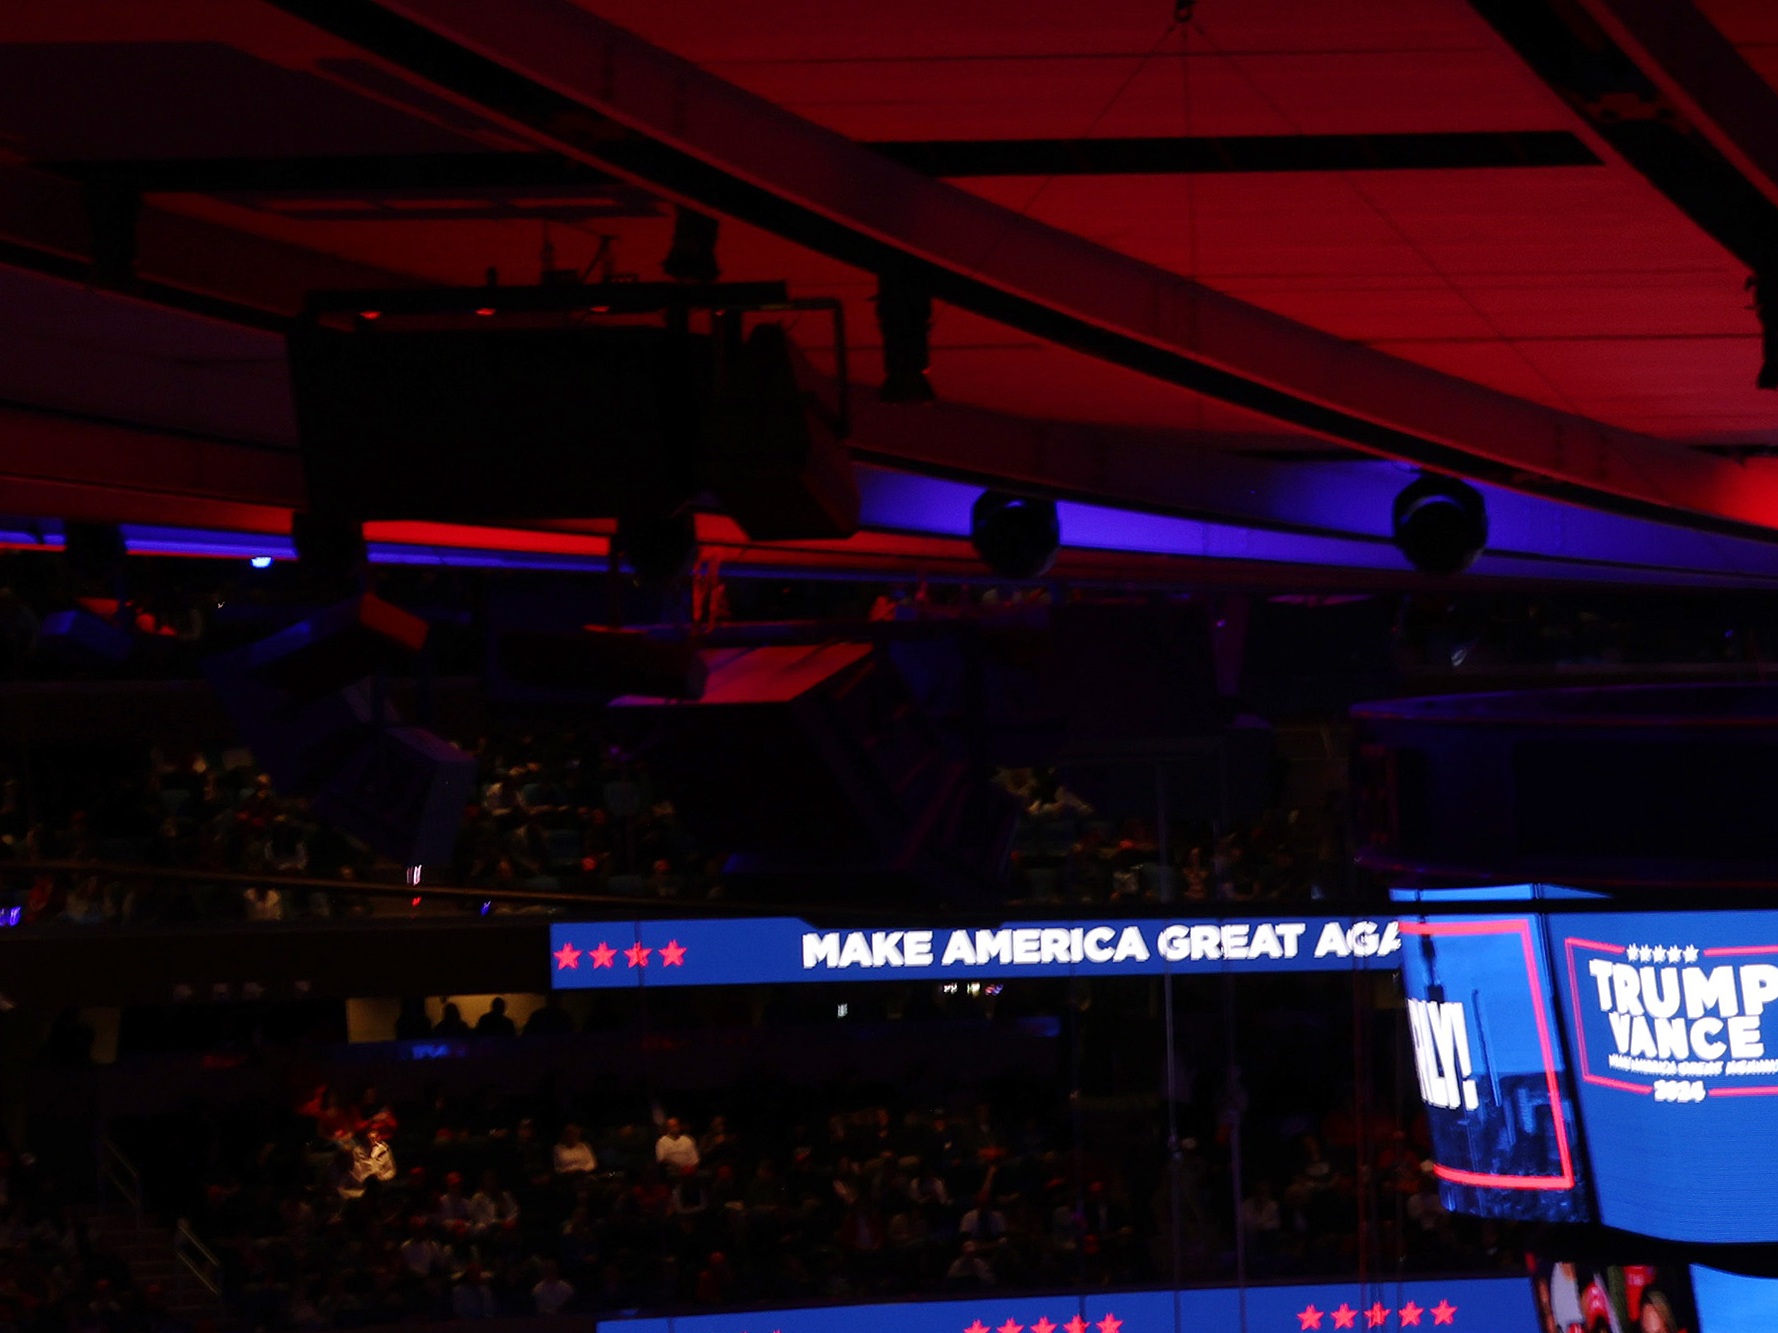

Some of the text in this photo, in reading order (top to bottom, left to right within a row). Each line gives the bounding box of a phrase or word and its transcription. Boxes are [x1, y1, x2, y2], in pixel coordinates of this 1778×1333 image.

[801, 929, 933, 970] MAKE
[942, 925, 1150, 967] AMERICA
[1158, 922, 1306, 961] GREAT
[1609, 1012, 1765, 1061] VANCE
